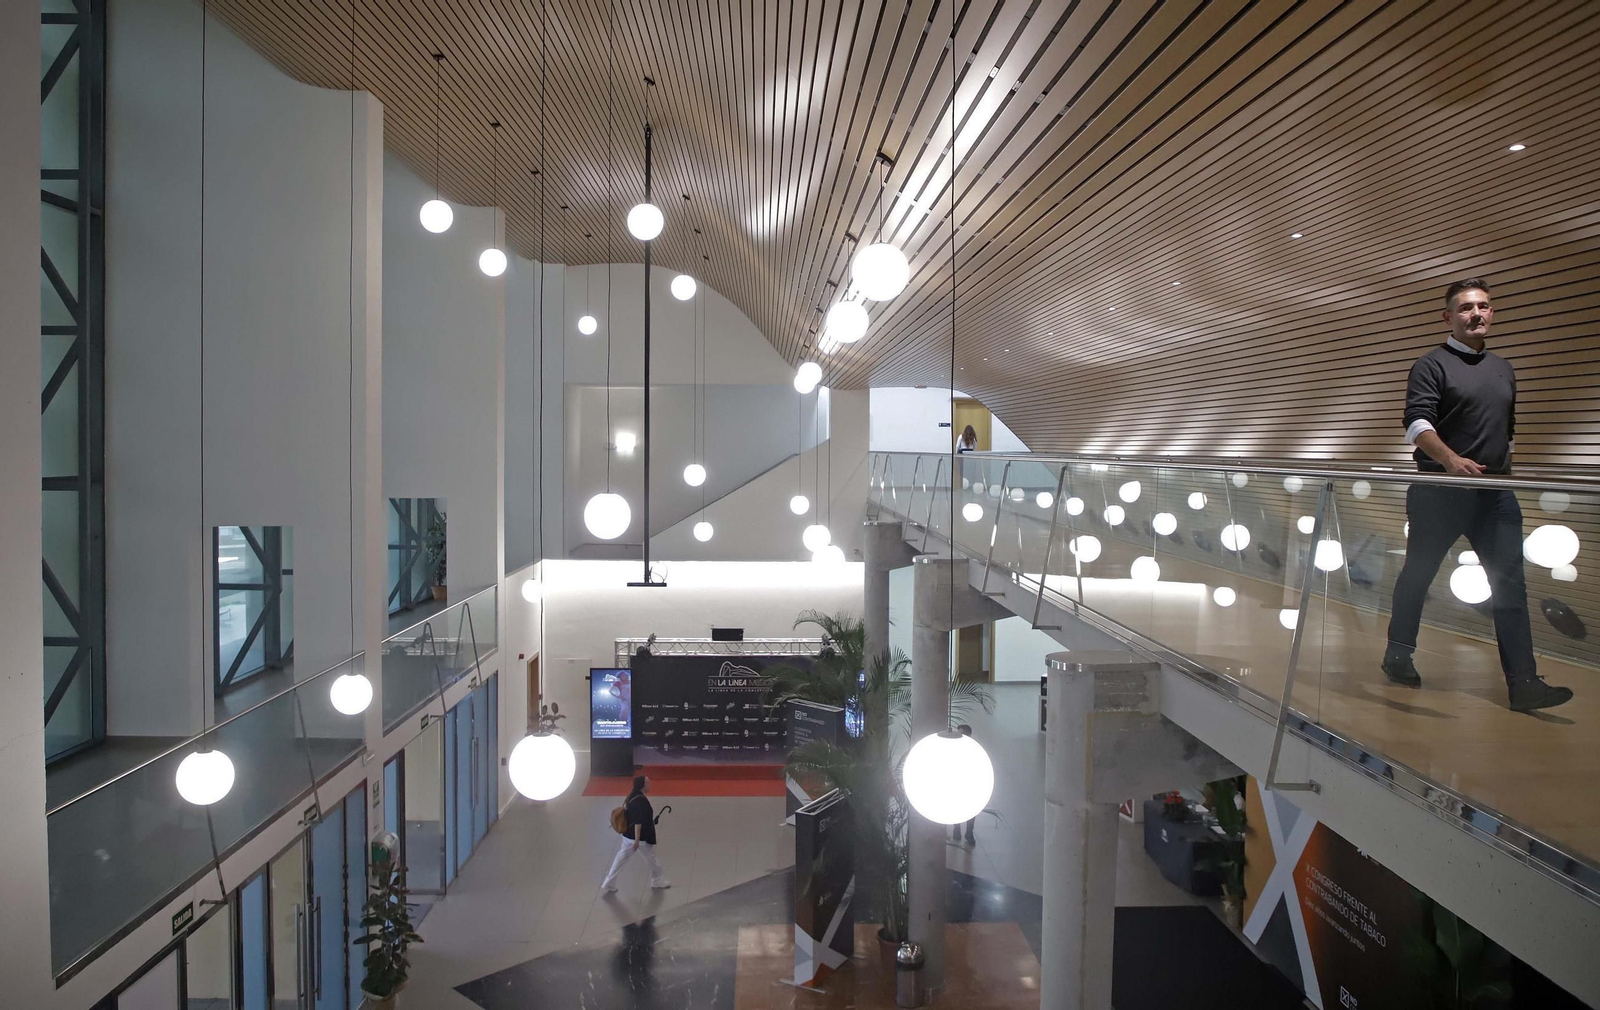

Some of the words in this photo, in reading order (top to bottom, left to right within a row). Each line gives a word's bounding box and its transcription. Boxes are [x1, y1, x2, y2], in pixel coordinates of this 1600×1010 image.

[717, 678, 726, 687] LA
[1311, 867, 1343, 898] CONGRESO
[1343, 890, 1368, 918] FRENTE
[1369, 909, 1378, 926] AL
[173, 907, 192, 930] SALIDA
[1305, 877, 1349, 918] CONTRABANDO
[1349, 911, 1359, 927] DE
[1360, 918, 1387, 948] TABACO
[1325, 914, 1350, 939] avanzando
[1349, 932, 1366, 952] juntos
[1349, 994, 1358, 1007] NO
